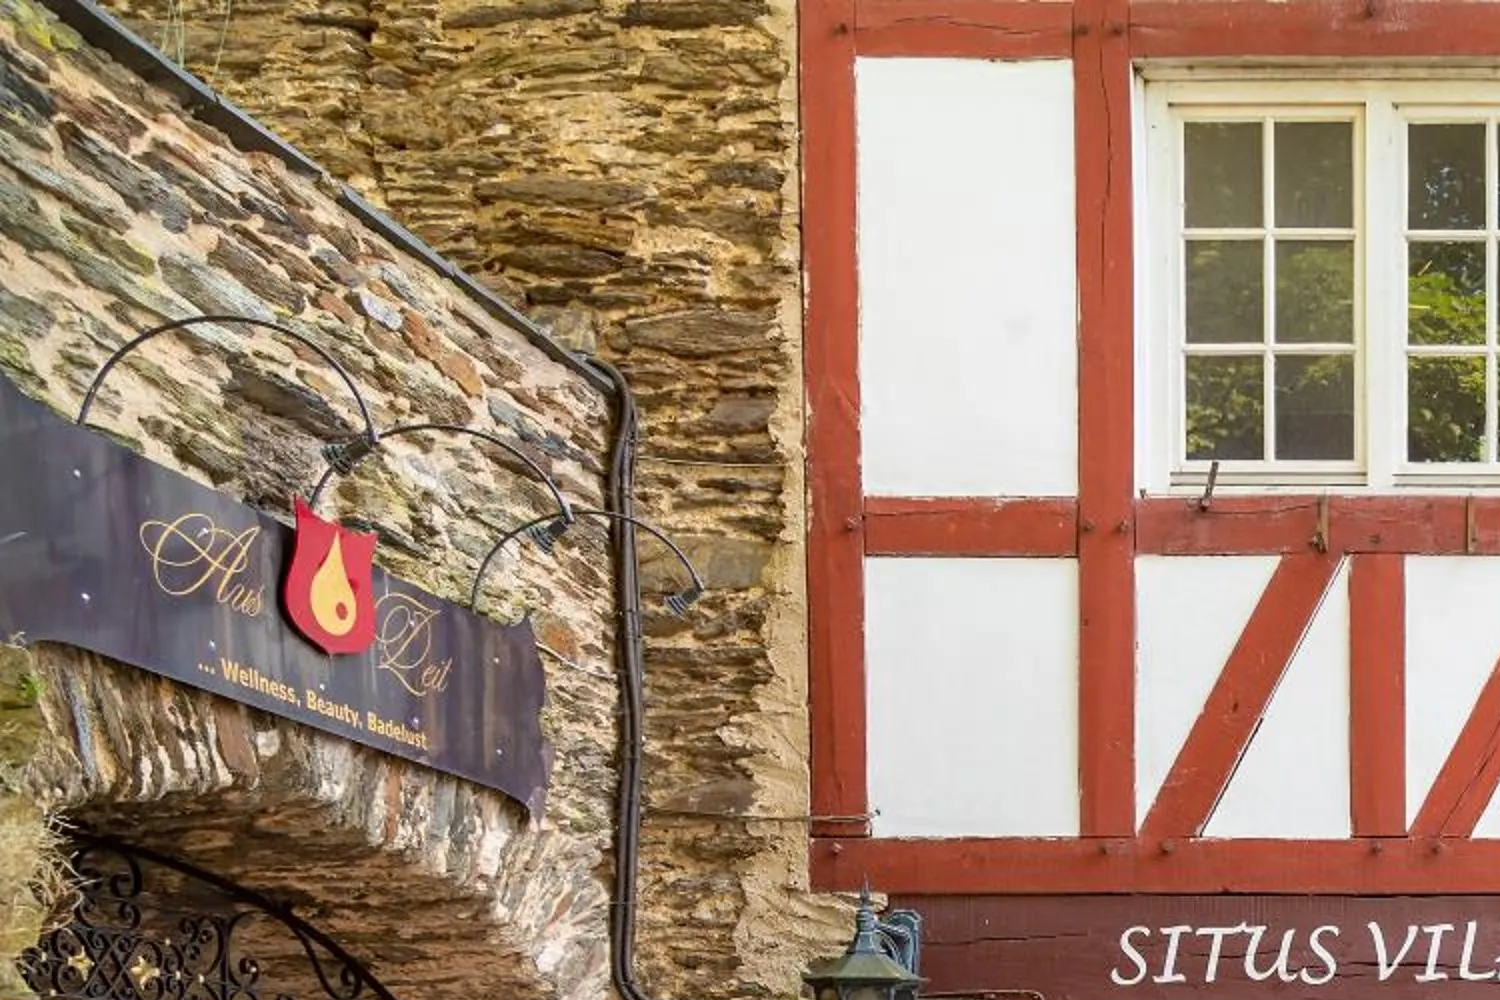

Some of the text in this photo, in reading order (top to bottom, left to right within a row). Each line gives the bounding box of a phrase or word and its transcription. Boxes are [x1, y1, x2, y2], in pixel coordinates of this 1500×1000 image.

[139, 512, 265, 618] Aus
[221, 657, 301, 708] Wellness,
[306, 689, 363, 730] Beauty,
[367, 710, 429, 751] Badelust
[1110, 920, 1340, 986] SITUS
